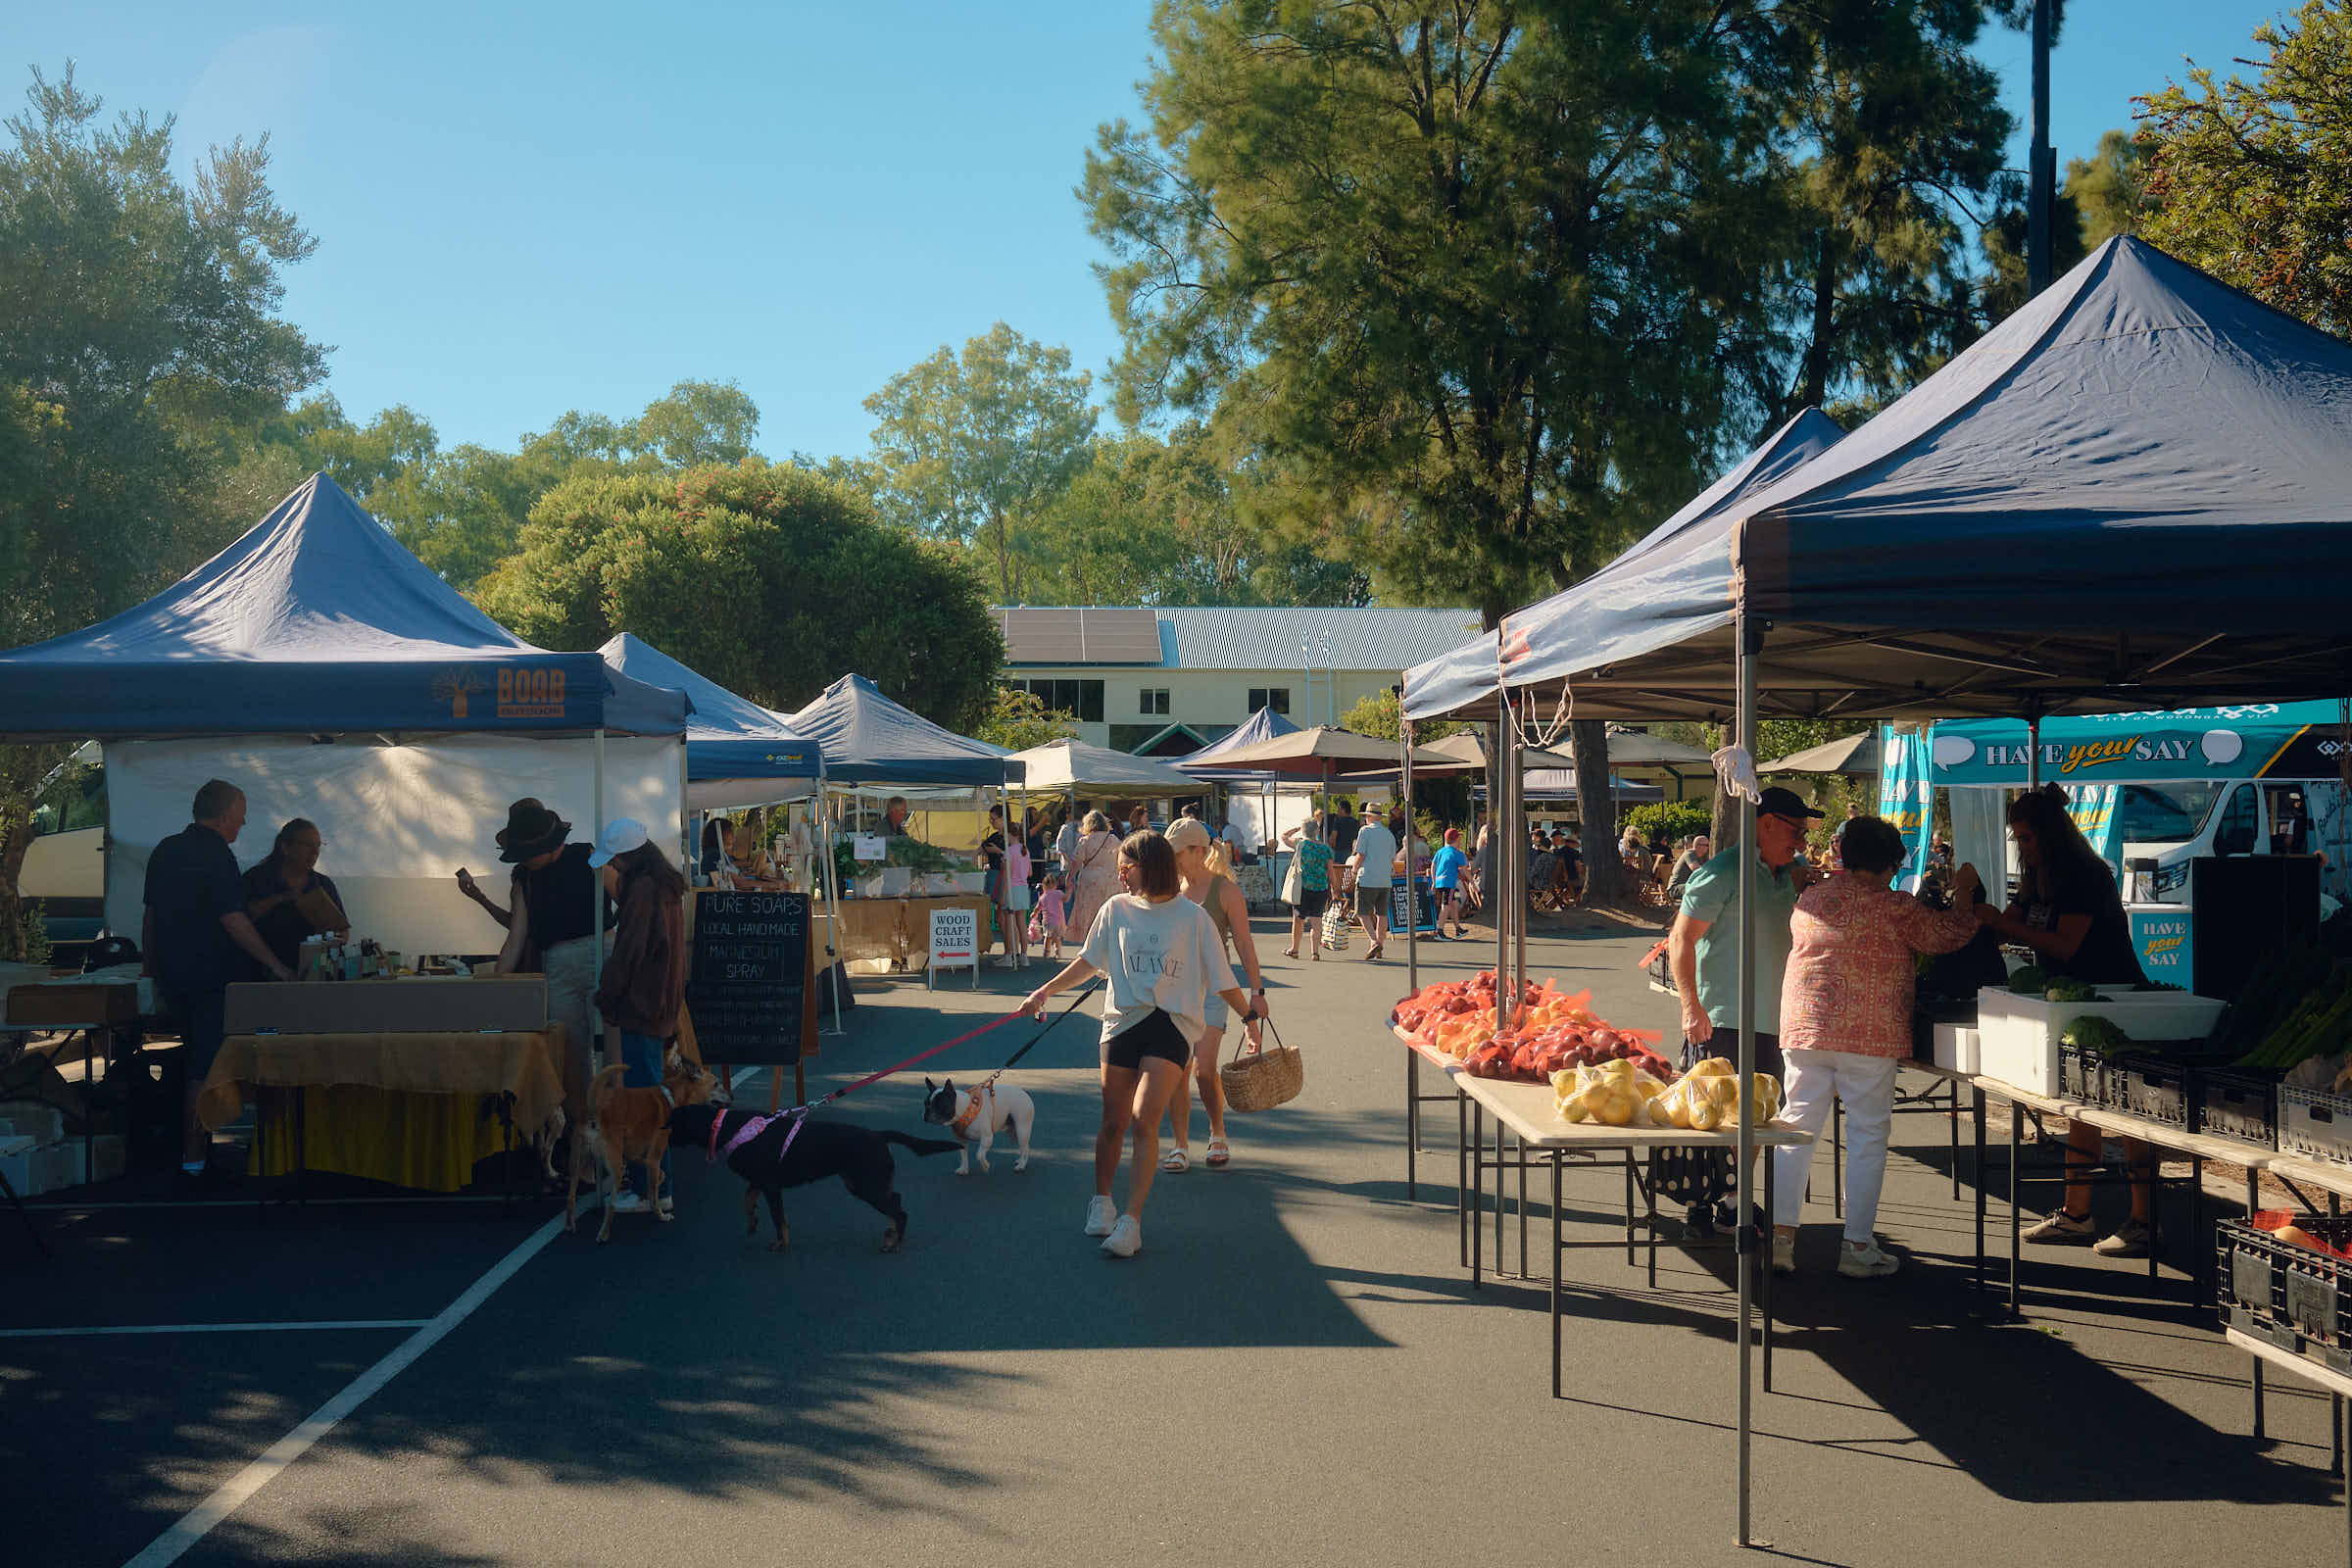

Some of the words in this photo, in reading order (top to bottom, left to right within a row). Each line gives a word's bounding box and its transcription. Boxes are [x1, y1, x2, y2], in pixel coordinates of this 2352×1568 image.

[497, 668, 565, 703] BOAB
[2061, 735, 2141, 773] your
[2135, 740, 2194, 761] SAY
[706, 895, 746, 914] PURE
[752, 896, 803, 915] SOAPS
[937, 915, 970, 925] WOOD
[702, 922, 735, 936] LOCAL
[935, 926, 972, 936] CRAFT
[2142, 922, 2186, 935] HAVE
[935, 937, 971, 947] SALES
[2143, 935, 2185, 956] your
[2149, 953, 2180, 966] SAY
[725, 963, 765, 979] SPRAY
